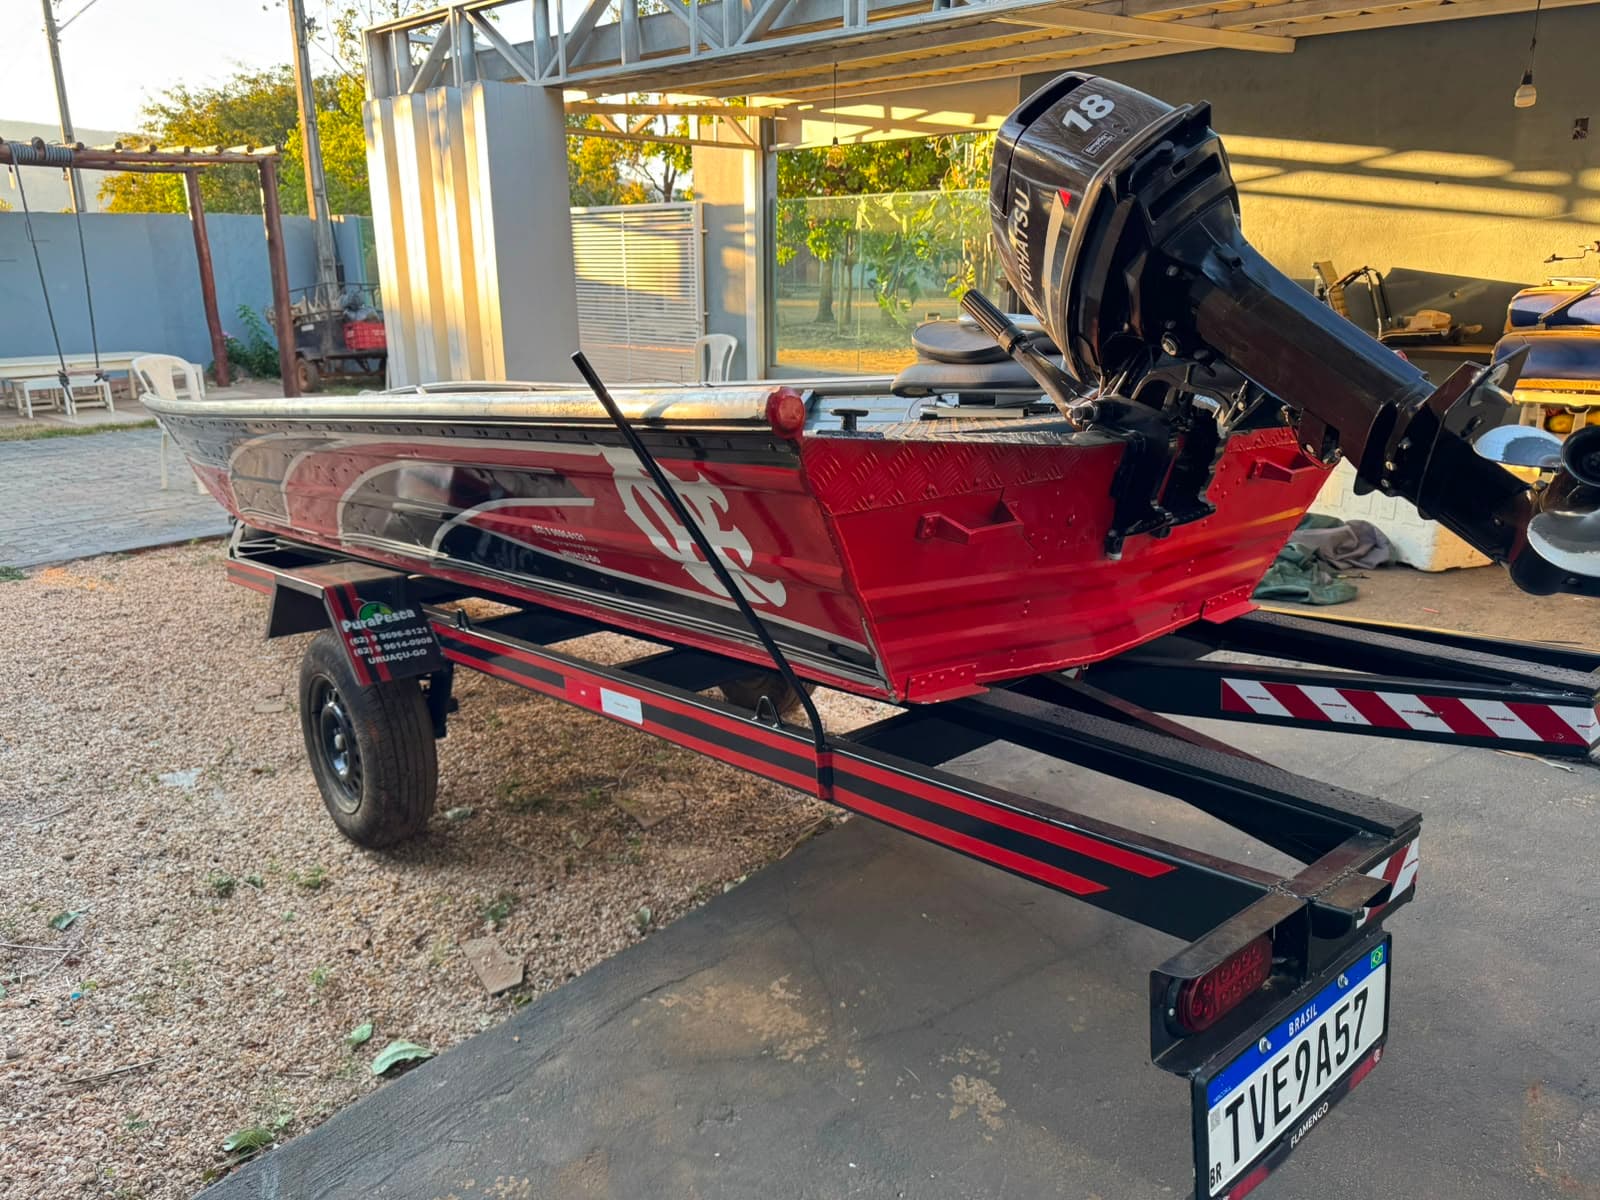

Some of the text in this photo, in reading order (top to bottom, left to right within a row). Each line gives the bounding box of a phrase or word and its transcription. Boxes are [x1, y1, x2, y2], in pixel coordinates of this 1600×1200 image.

[1062, 94, 1115, 132] 18
[1015, 188, 1034, 292] TOHATSU
[341, 609, 416, 632] PuraPesca
[1288, 1004, 1318, 1037] BRASIL
[1225, 986, 1369, 1166] TVE9A57
[1291, 1102, 1329, 1148] FLAMENGO
[1210, 1162, 1222, 1189] BR
